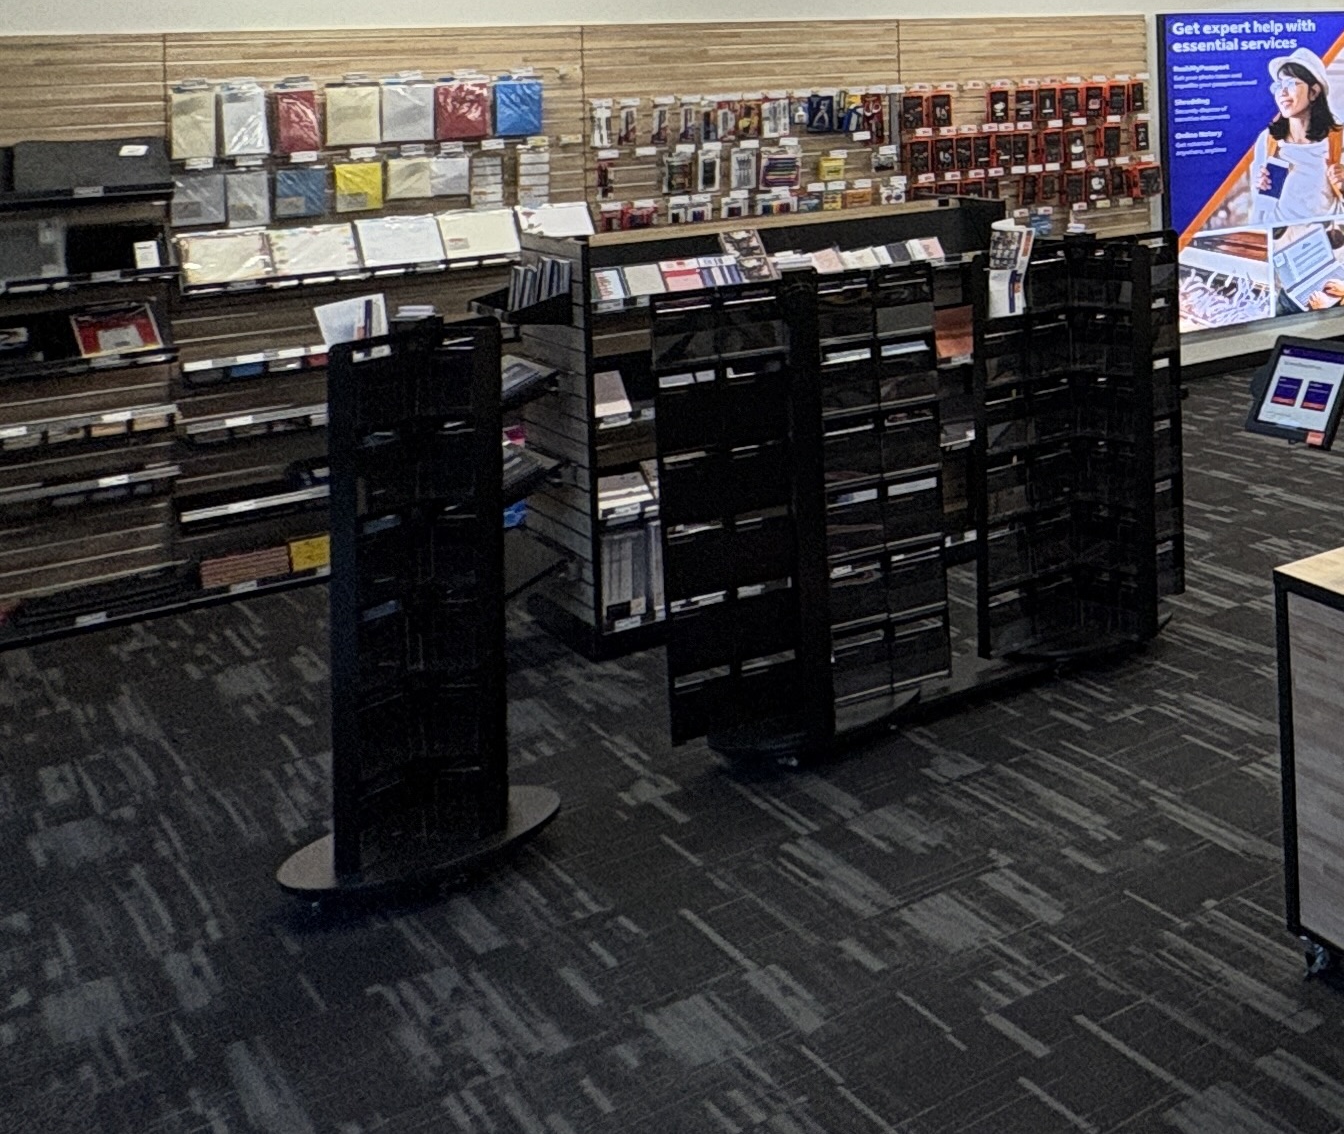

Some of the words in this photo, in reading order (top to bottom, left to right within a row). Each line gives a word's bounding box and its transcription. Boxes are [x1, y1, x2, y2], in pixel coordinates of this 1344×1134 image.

[1172, 21, 1200, 35] Get
[1203, 21, 1251, 36] expert
[1253, 20, 1284, 35] help
[1286, 19, 1316, 33] with
[1172, 38, 1238, 52] essential
[1241, 37, 1297, 50] services
